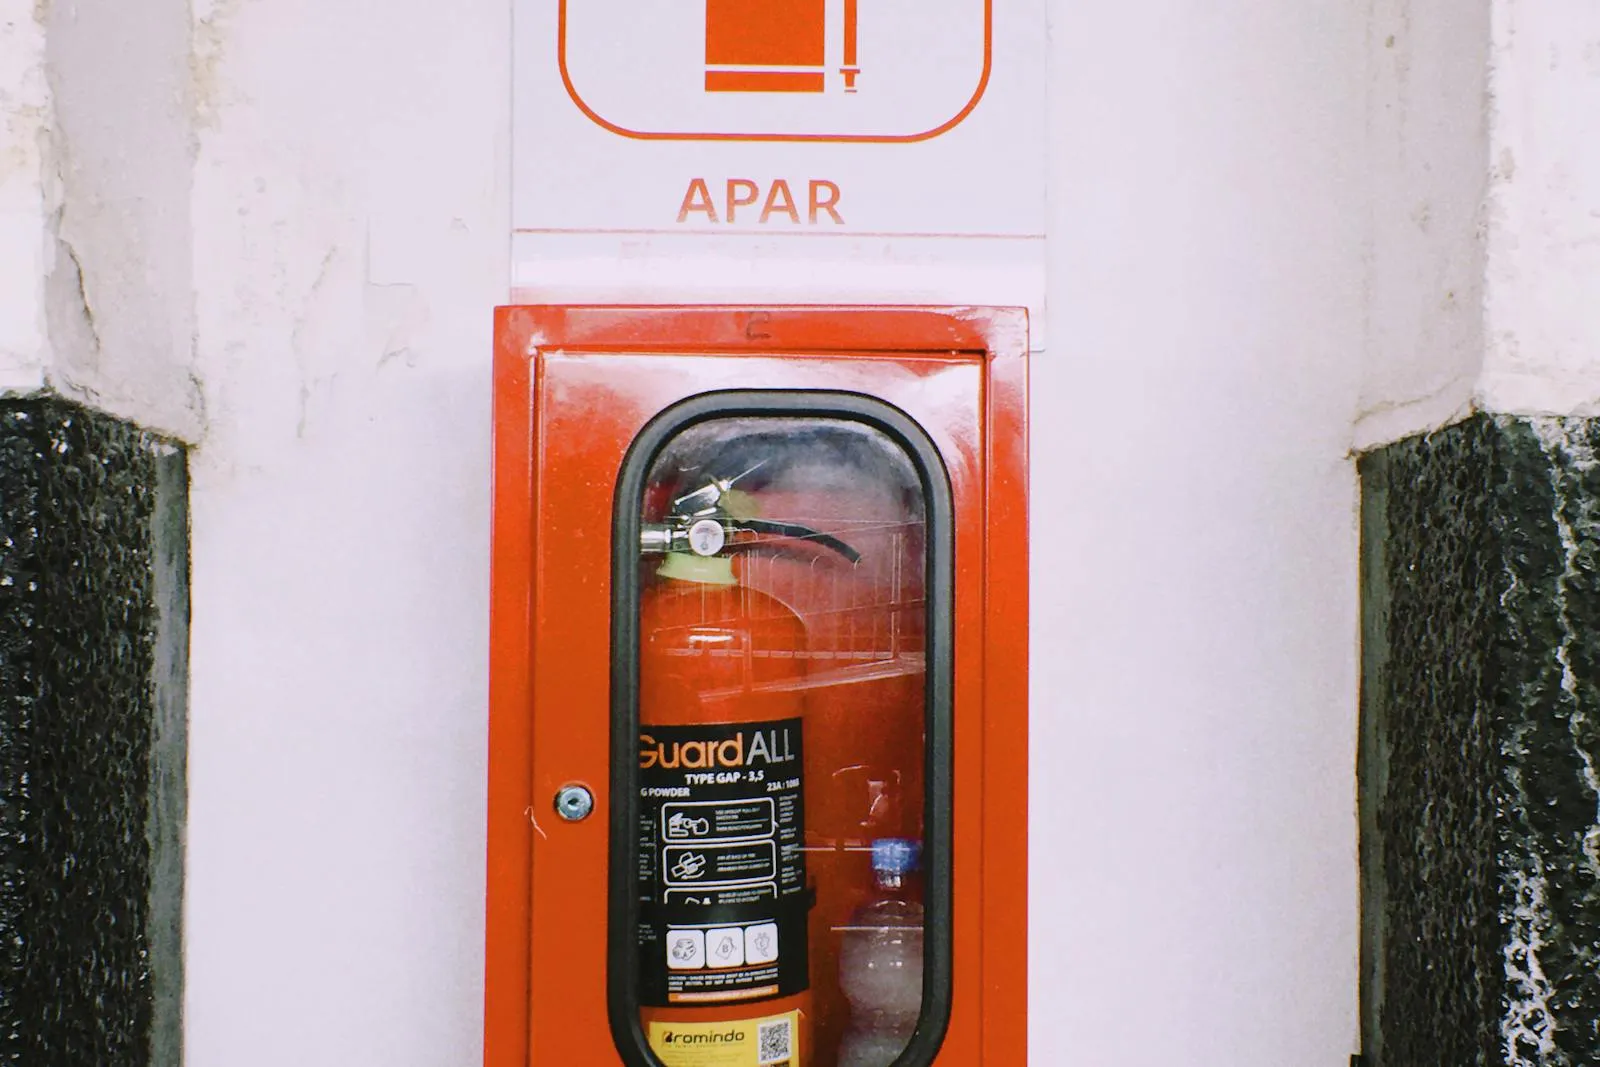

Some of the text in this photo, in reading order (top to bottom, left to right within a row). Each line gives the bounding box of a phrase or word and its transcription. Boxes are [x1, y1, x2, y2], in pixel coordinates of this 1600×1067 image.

[676, 178, 846, 225] APAR
[685, 773, 715, 785] TYPE
[716, 772, 742, 784] GAP
[649, 786, 690, 797] POWDER
